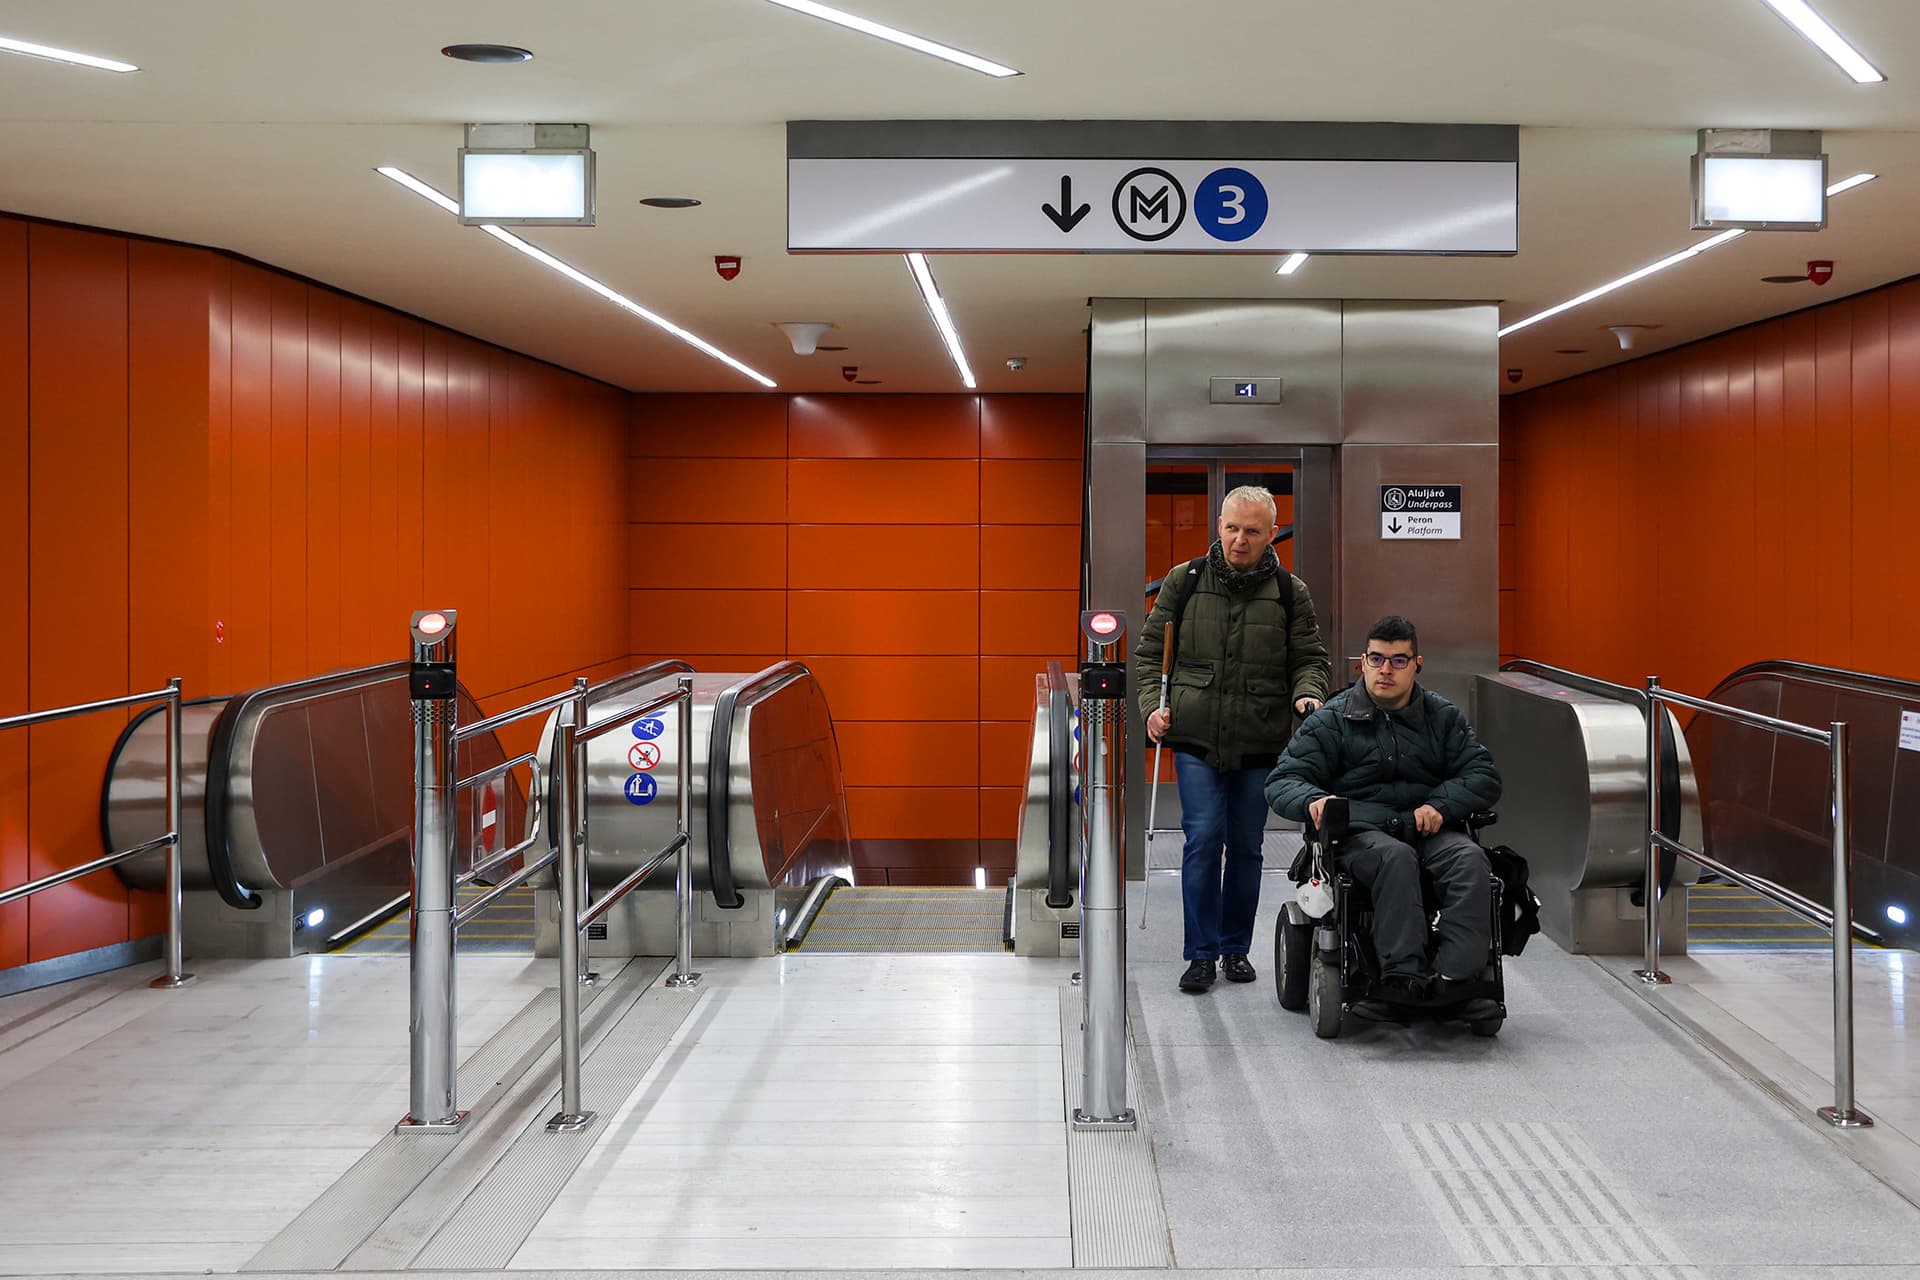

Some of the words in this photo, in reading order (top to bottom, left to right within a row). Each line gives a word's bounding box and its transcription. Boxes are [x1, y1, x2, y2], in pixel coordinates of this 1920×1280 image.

[1217, 184, 1247, 225] 3
[1239, 383, 1252, 397] -1
[1407, 489, 1445, 499] Aluljáró
[1407, 500, 1453, 510] Underpass
[1407, 516, 1433, 524] Peron
[1407, 526, 1443, 536] Platform
